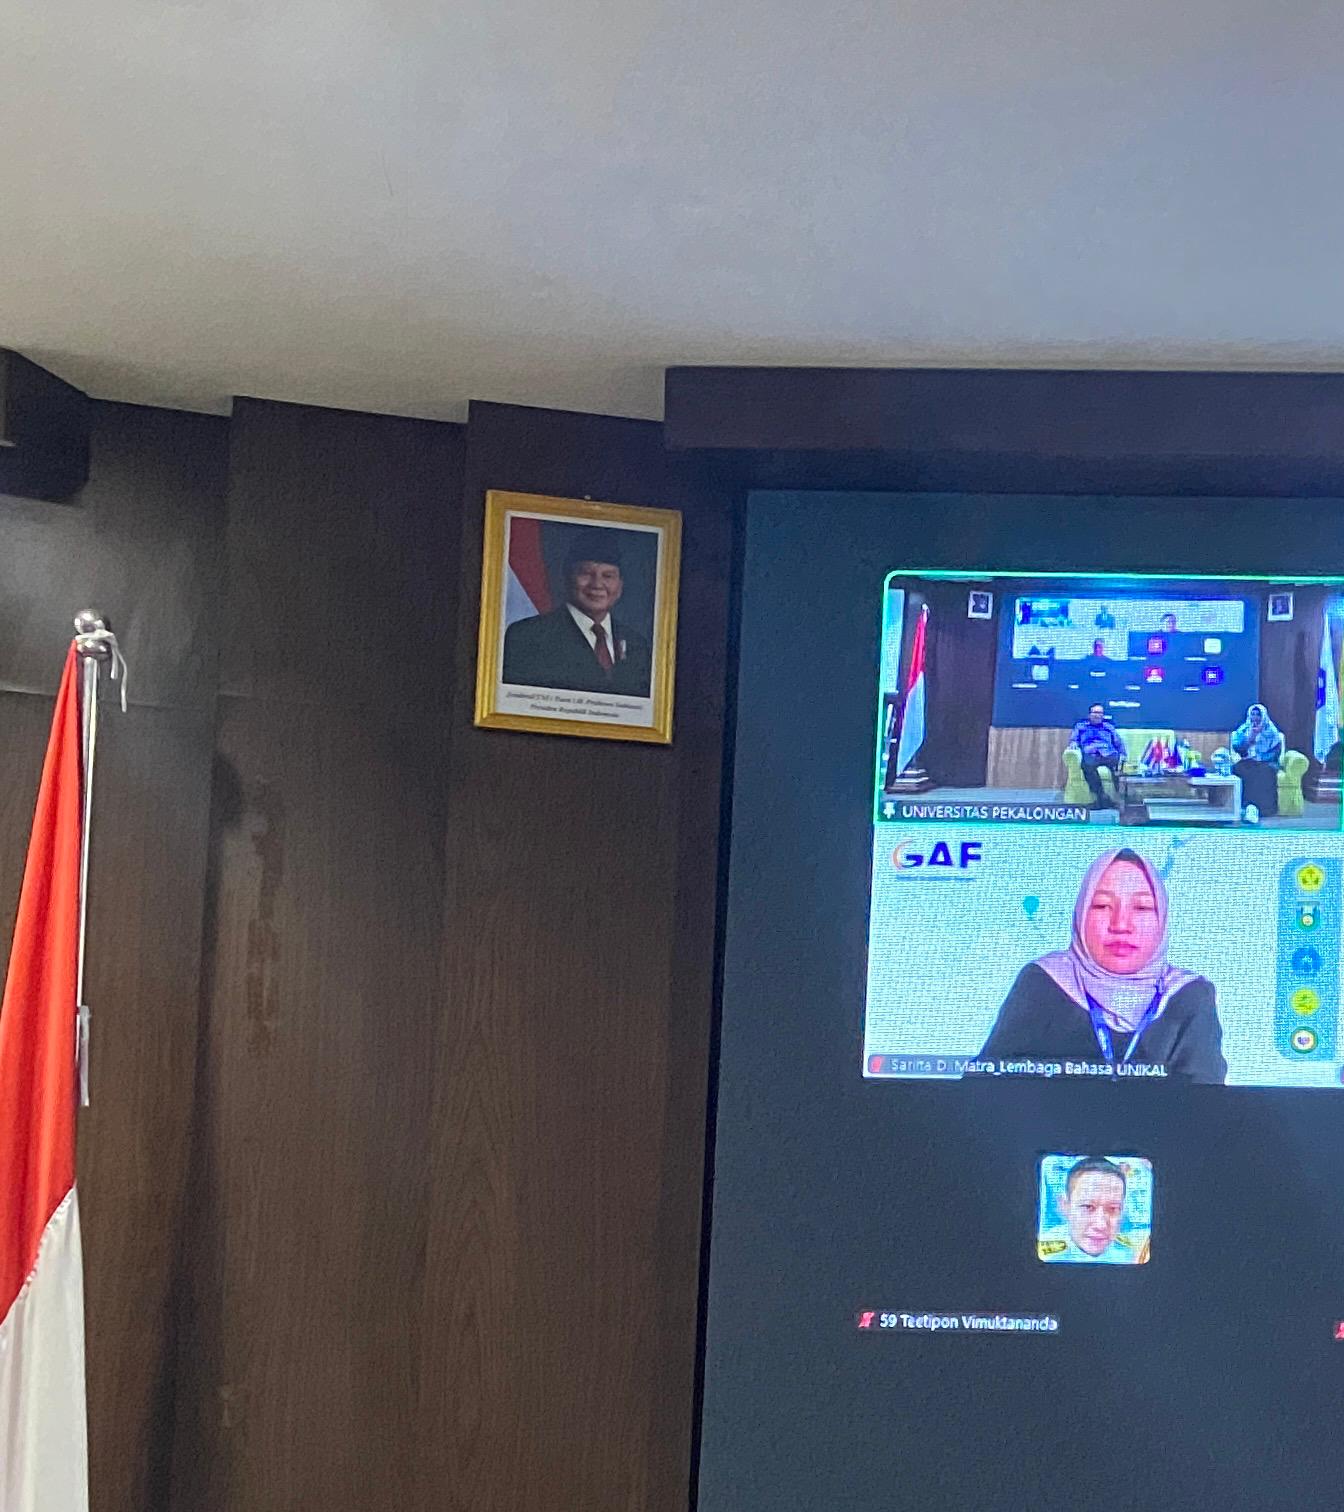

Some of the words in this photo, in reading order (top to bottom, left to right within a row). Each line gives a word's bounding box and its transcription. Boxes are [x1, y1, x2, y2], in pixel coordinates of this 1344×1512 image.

[902, 804, 988, 819] UNIVERSITAS
[992, 804, 1087, 821] PEKALONGAN
[893, 839, 983, 869] GAF
[1065, 1061, 1112, 1075] Bahasa
[1116, 1063, 1168, 1077] UNIKAL
[961, 1315, 1058, 1331] Vimuktananda
